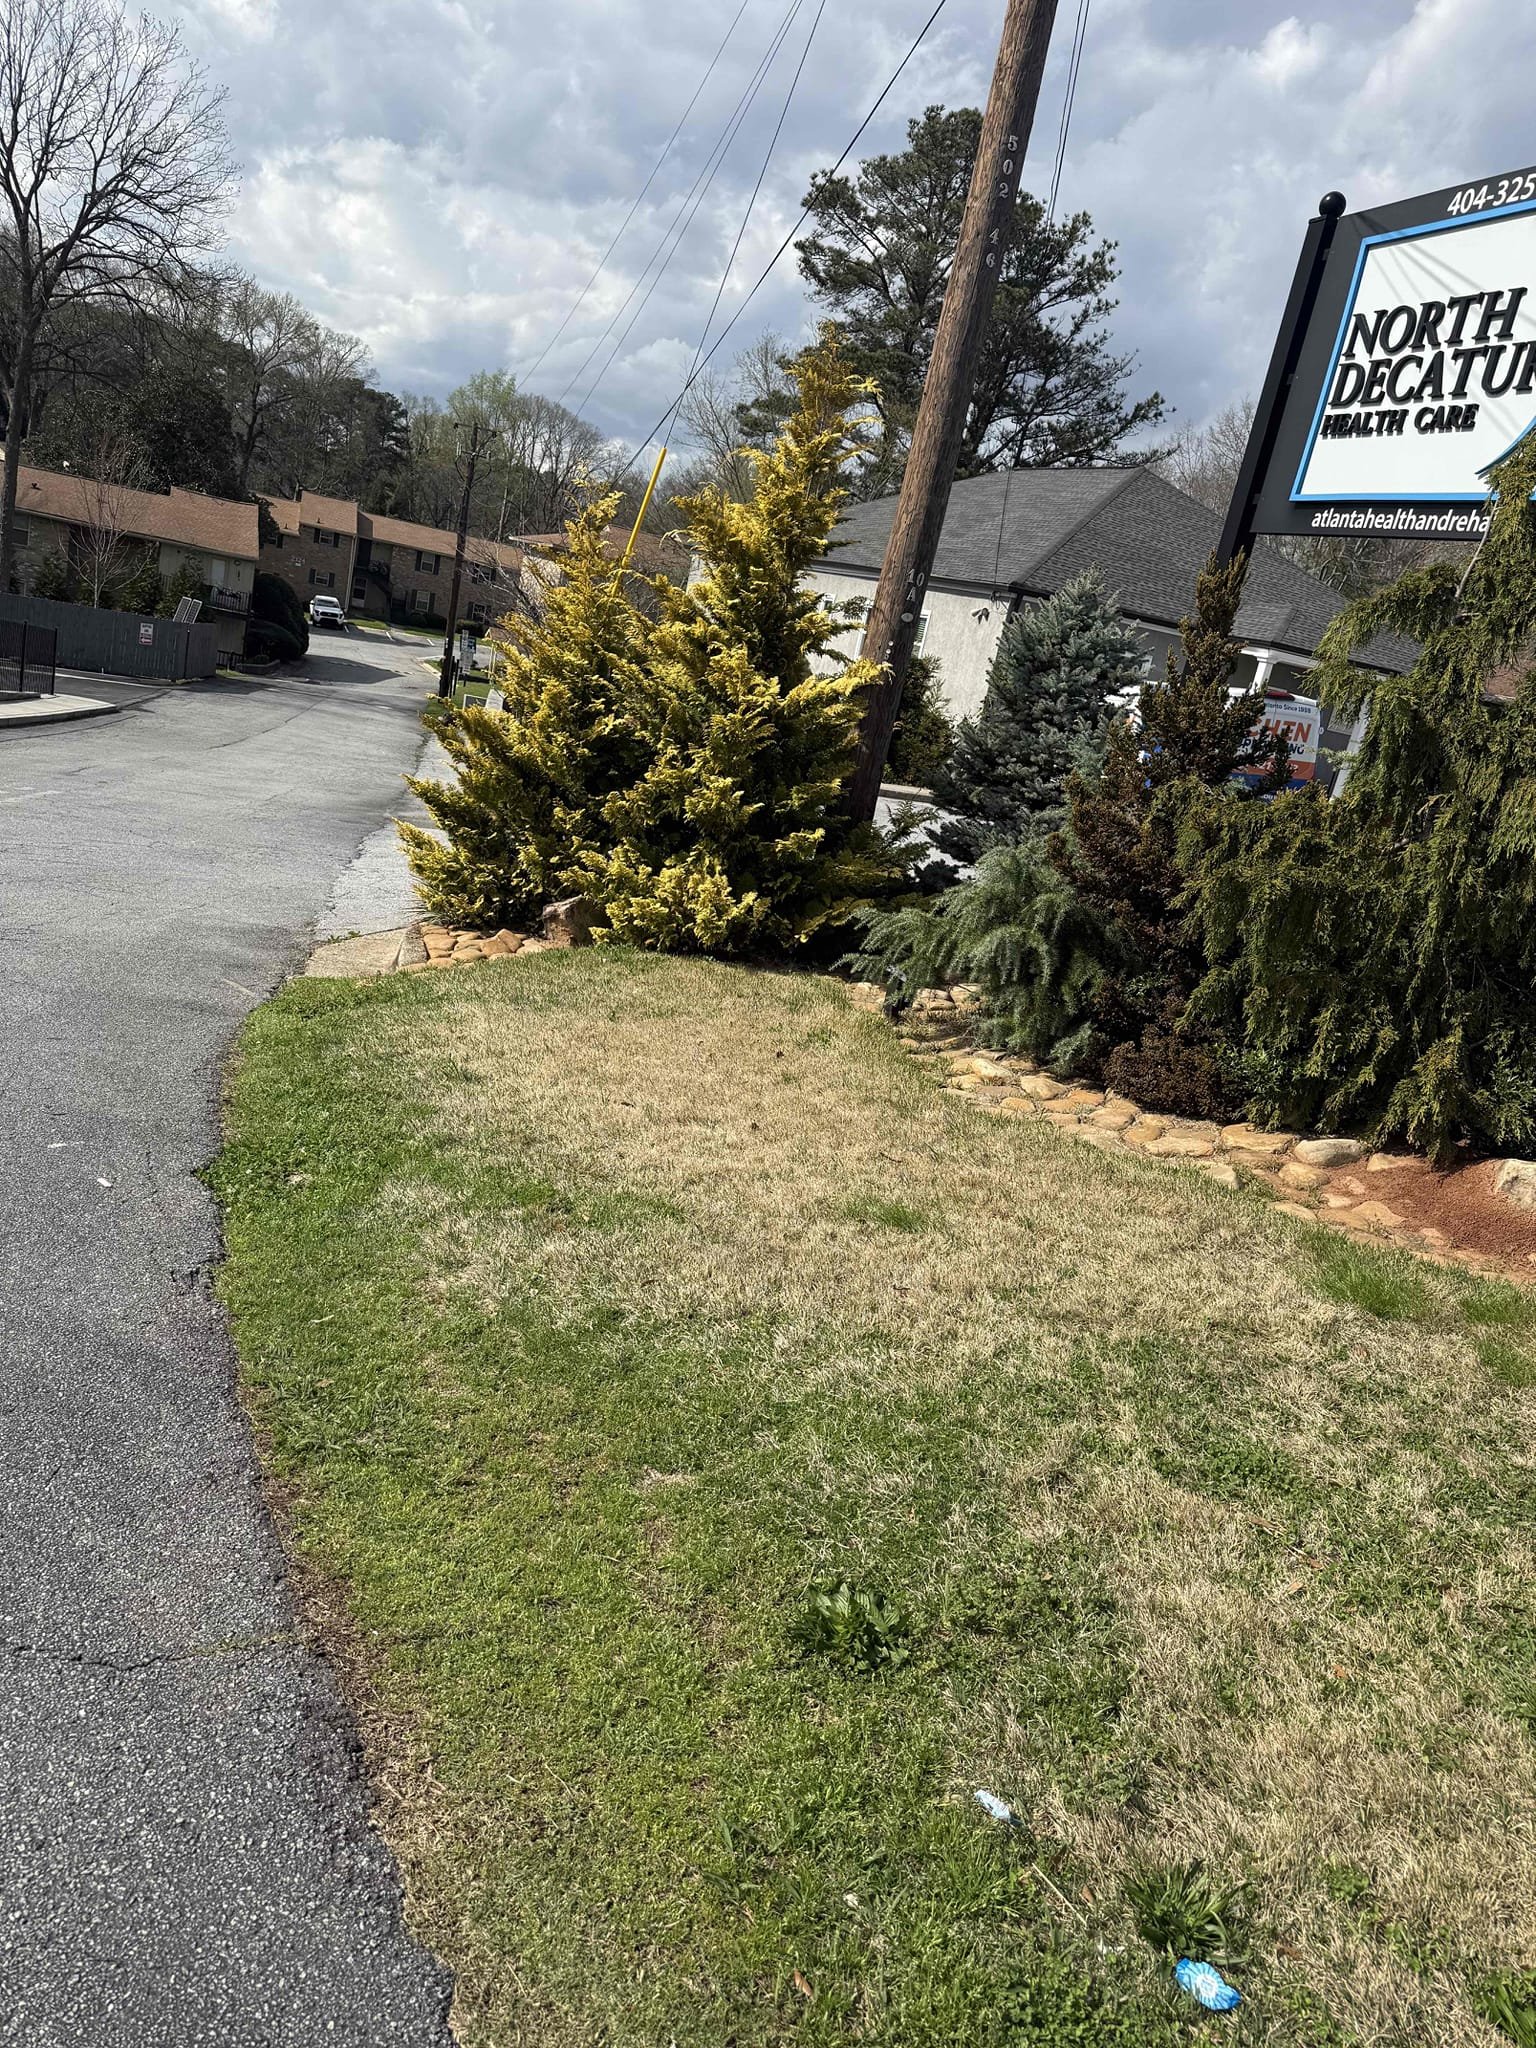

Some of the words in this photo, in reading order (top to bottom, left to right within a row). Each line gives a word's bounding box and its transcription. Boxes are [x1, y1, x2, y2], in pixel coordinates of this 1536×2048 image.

[1342, 287, 1528, 358] NORTH
[1320, 409, 1409, 437] HEALTH
[1414, 403, 1479, 433] CARE
